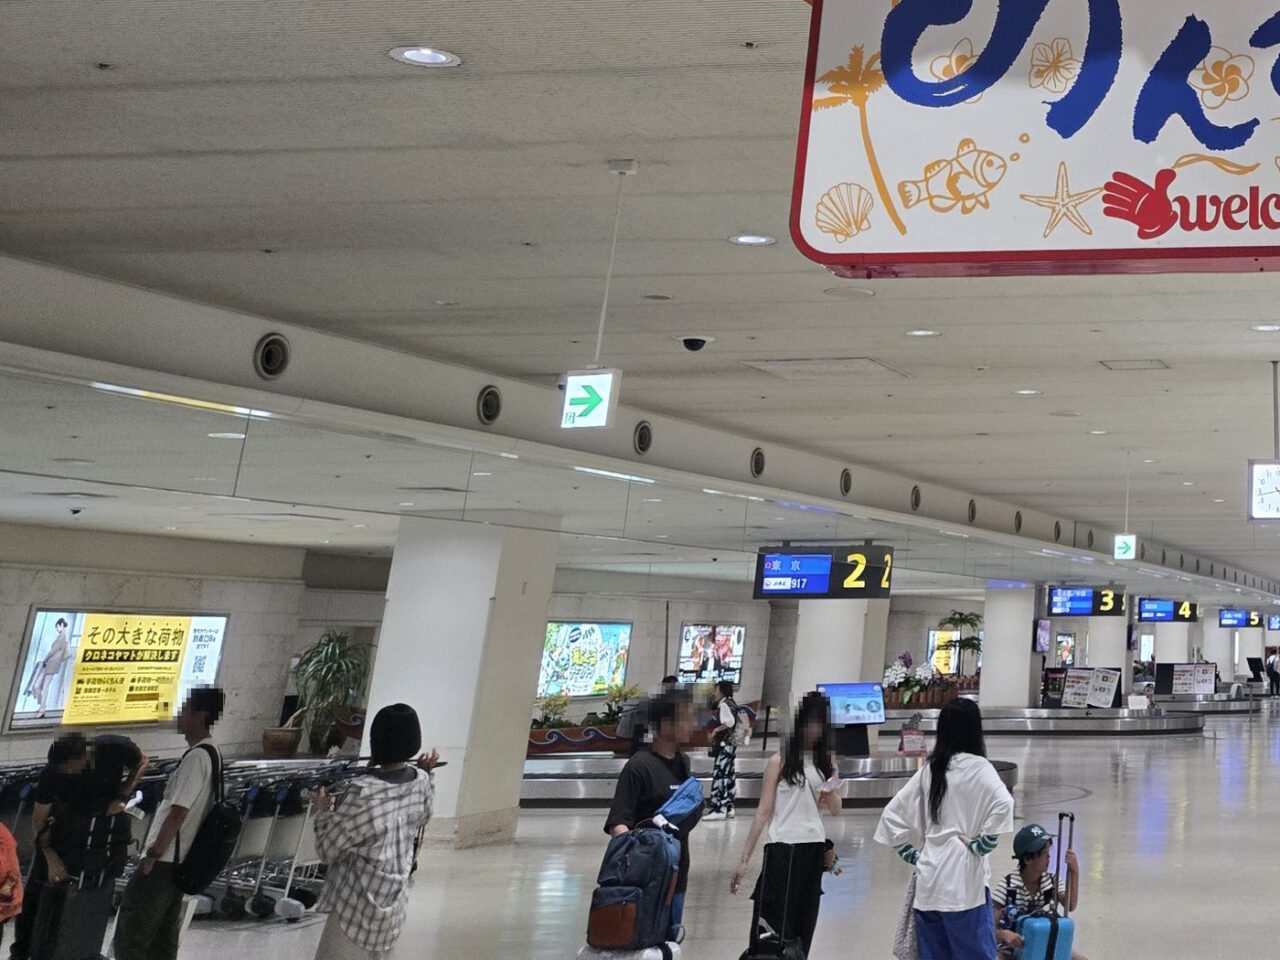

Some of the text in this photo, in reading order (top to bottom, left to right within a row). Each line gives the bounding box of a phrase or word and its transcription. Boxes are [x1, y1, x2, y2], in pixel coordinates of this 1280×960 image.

[771, 559, 801, 572] 東京
[843, 553, 867, 588] 2
[880, 553, 892, 588] 2
[791, 578, 808, 589] 917
[1100, 589, 1114, 611] 3
[1178, 601, 1191, 619] 4
[1250, 611, 1259, 626] 5
[87, 625, 185, 646] その大きな荷物
[85, 650, 179, 661] クロネコヤマトが解決します
